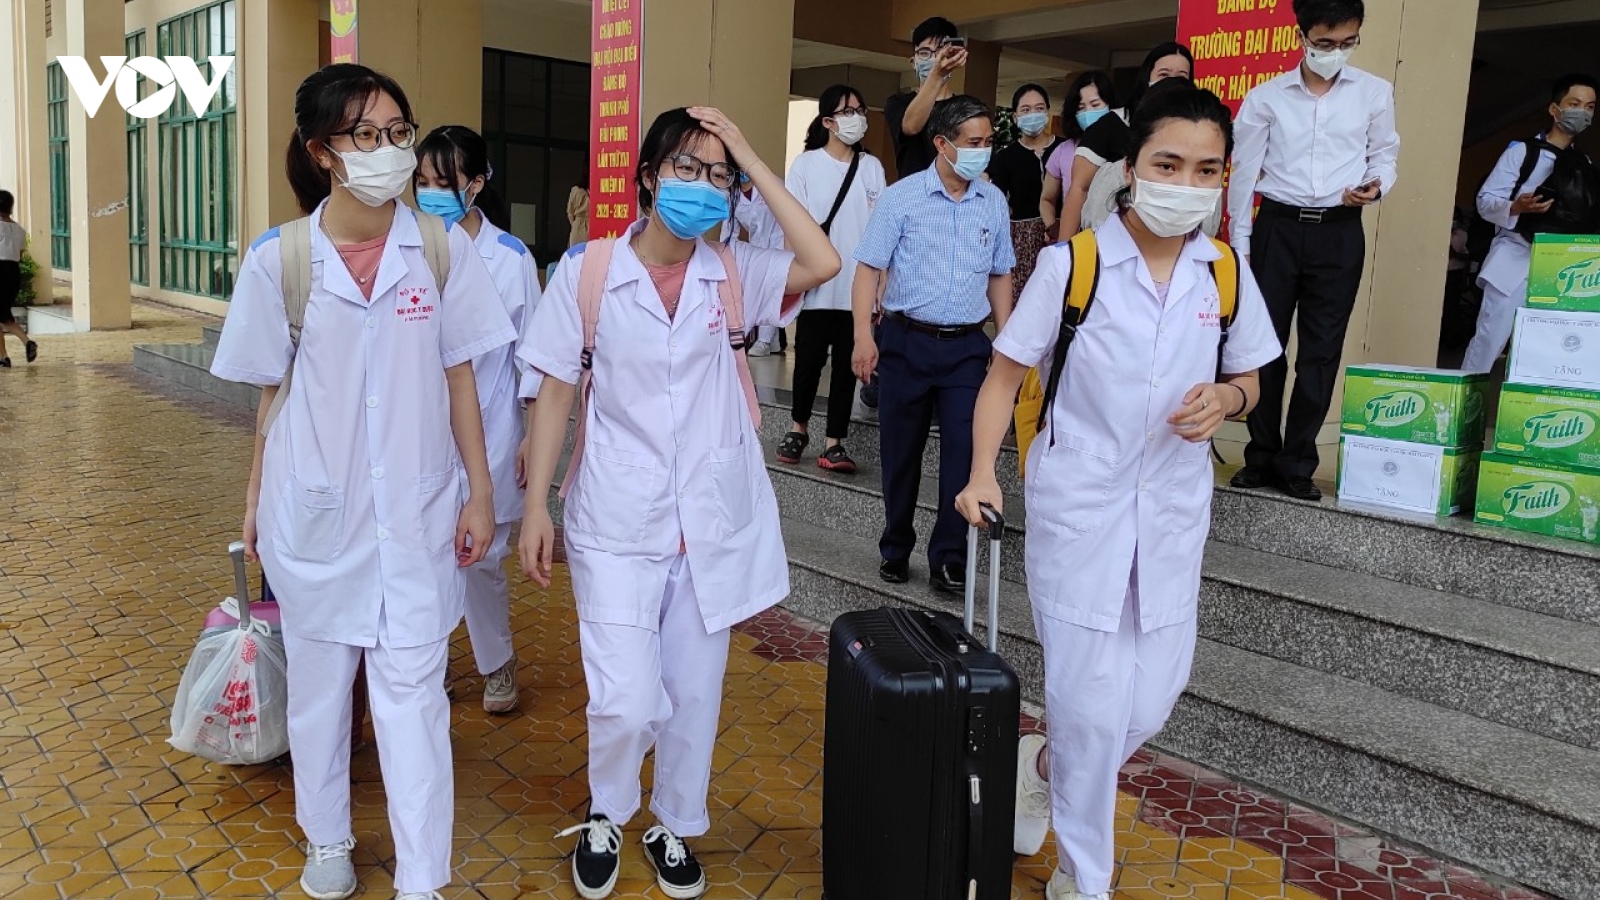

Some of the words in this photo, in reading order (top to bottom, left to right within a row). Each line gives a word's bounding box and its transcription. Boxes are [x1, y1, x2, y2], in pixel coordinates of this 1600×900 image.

[1190, 27, 1241, 60] TRƯỜNG
[1245, 27, 1269, 60] ĐẠI
[1271, 24, 1300, 57] HỌC
[1366, 394, 1416, 422] Faith
[1525, 413, 1584, 443] Faith
[1504, 484, 1560, 514] Faith
